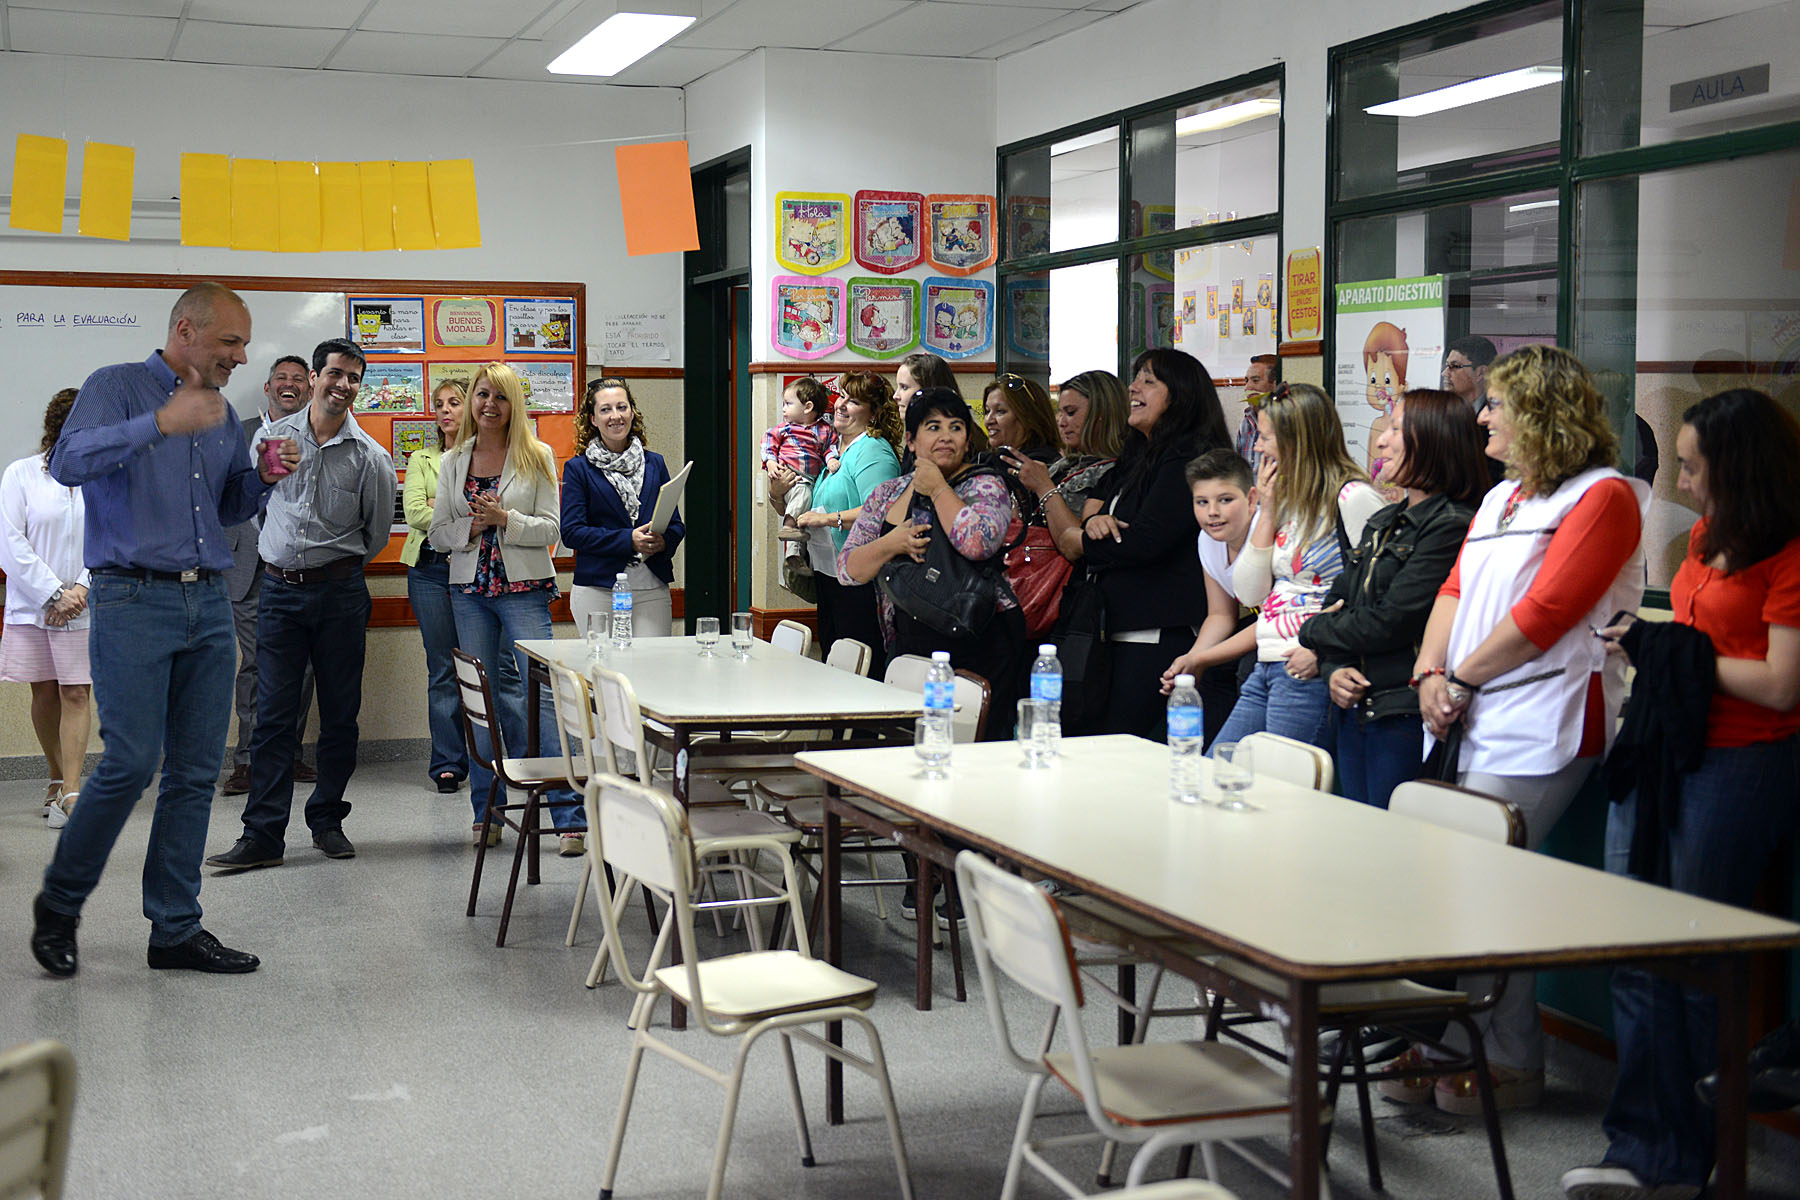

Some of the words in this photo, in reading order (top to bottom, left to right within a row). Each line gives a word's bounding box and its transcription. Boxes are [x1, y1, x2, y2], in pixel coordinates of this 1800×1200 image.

[1691, 75, 1745, 104] AULA
[799, 203, 828, 218] Hola
[1292, 272, 1316, 286] TIRAR
[1338, 286, 1384, 306] APARATO
[1386, 281, 1443, 303] DIGESTIVO
[358, 307, 387, 315] Levanto
[388, 307, 396, 315] la
[509, 304, 519, 312] En
[509, 313, 535, 321] pasillos
[1291, 306, 1317, 320] CESTOS
[16, 312, 45, 323] PARA
[54, 314, 66, 323] LA
[73, 313, 137, 324] EVALUACIÓN
[448, 317, 483, 325] BUENOS
[383, 324, 407, 332] hablar
[446, 325, 486, 333] MODALES
[605, 330, 622, 339] ESTÁ
[537, 369, 568, 378] disculpas
